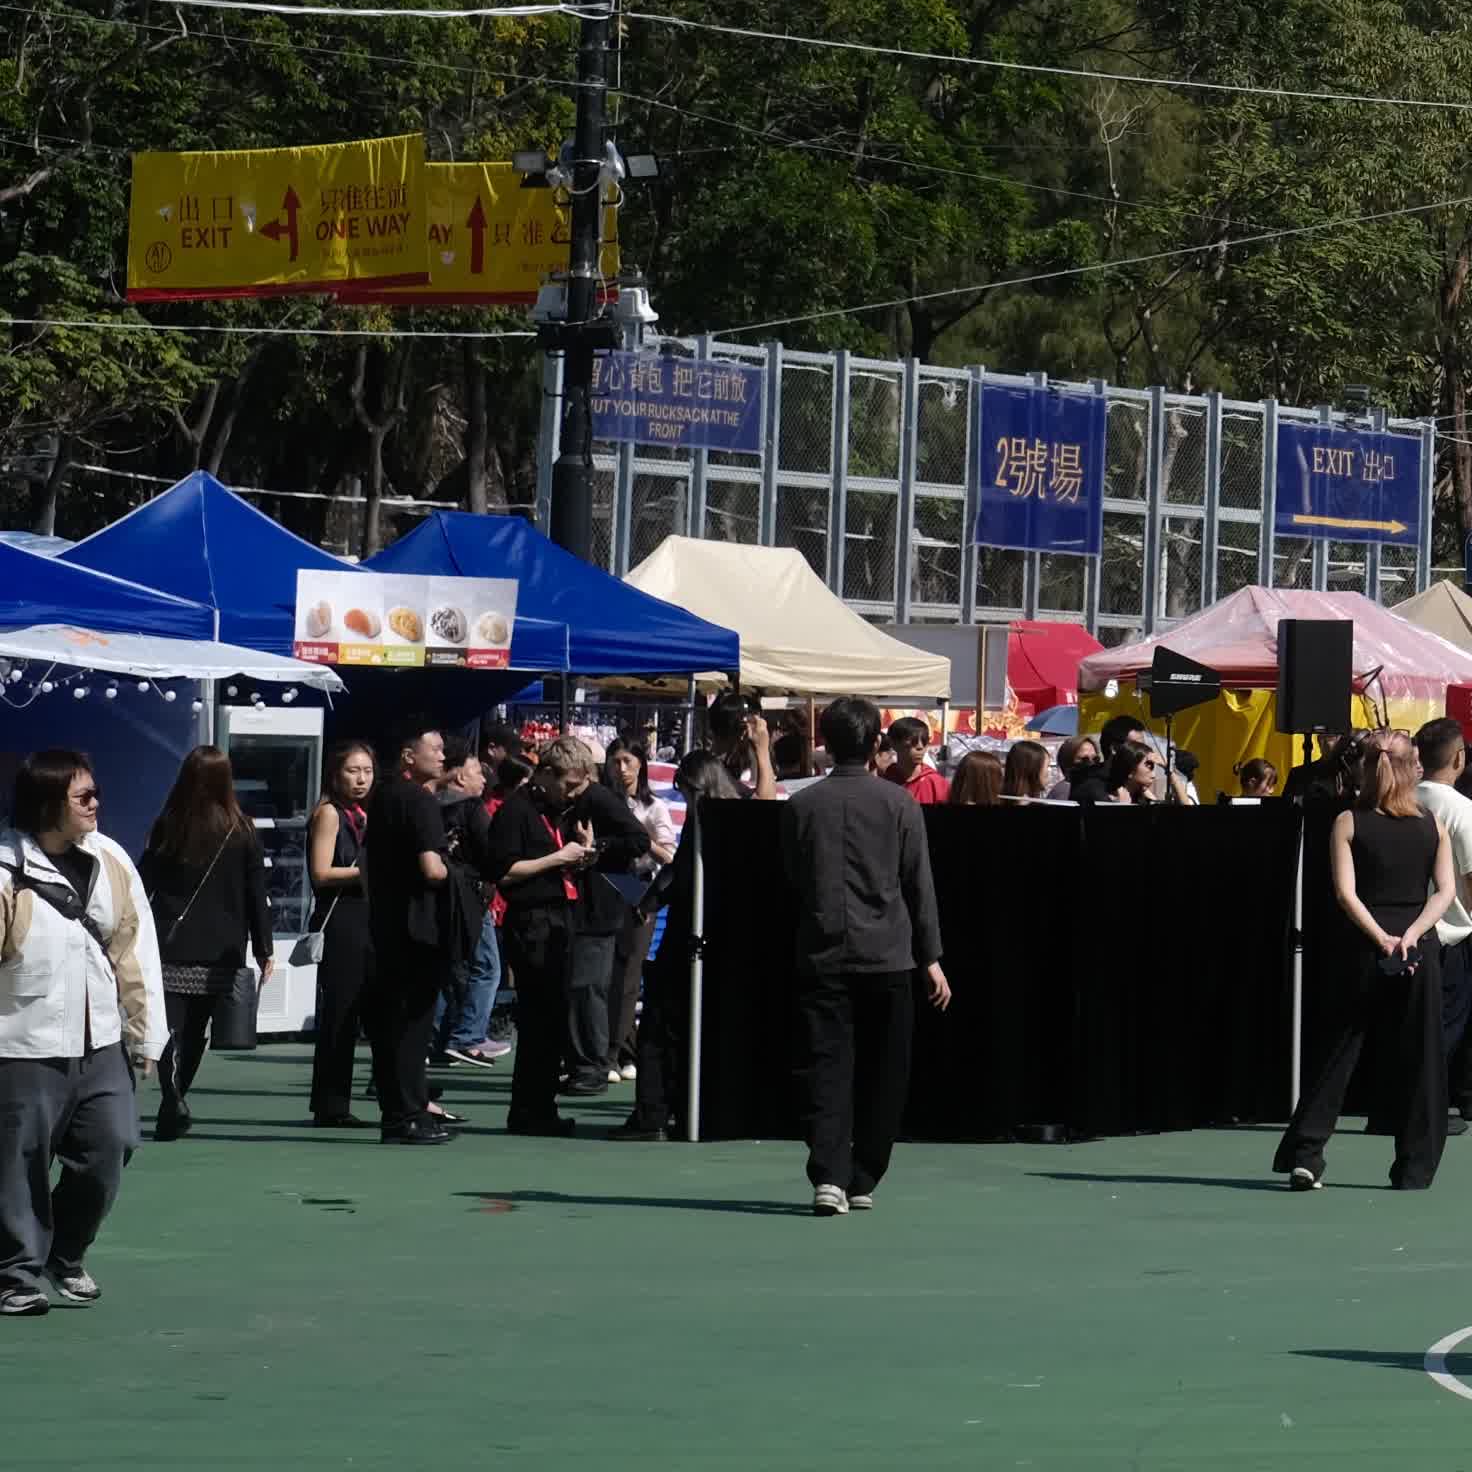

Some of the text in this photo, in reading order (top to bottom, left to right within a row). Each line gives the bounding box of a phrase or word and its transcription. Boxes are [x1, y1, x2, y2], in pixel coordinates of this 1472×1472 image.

[179, 195, 233, 222] 出口
[181, 227, 232, 249] EXIT
[316, 211, 411, 241] ONE WAY
[613, 400, 648, 417] YOUR
[648, 406, 709, 423] RUCKSACK
[722, 410, 740, 427] THE
[648, 422, 685, 439] FRONT
[995, 437, 1083, 504] 2號場
[1312, 447, 1354, 477] EXIT
[1362, 449, 1395, 482] 出口
